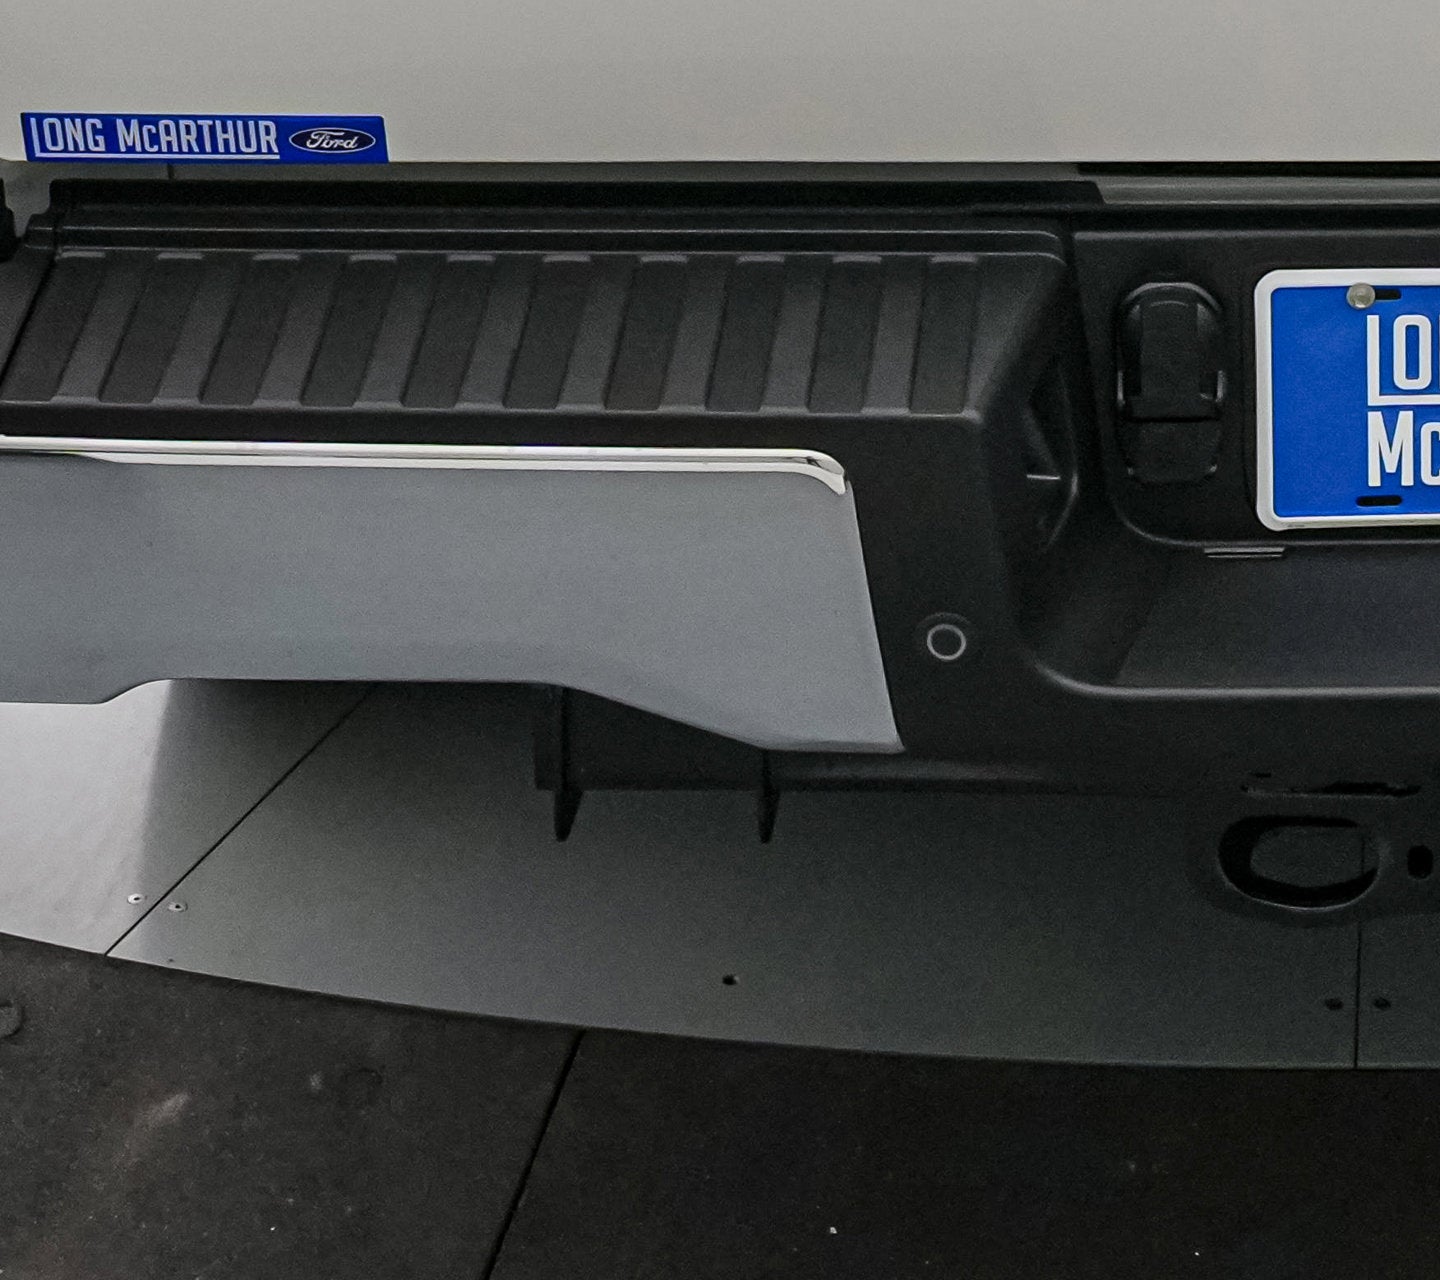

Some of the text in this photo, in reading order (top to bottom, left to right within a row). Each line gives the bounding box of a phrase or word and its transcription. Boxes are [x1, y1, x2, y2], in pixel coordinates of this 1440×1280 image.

[29, 116, 360, 157] LONG McARTHUR Ford
